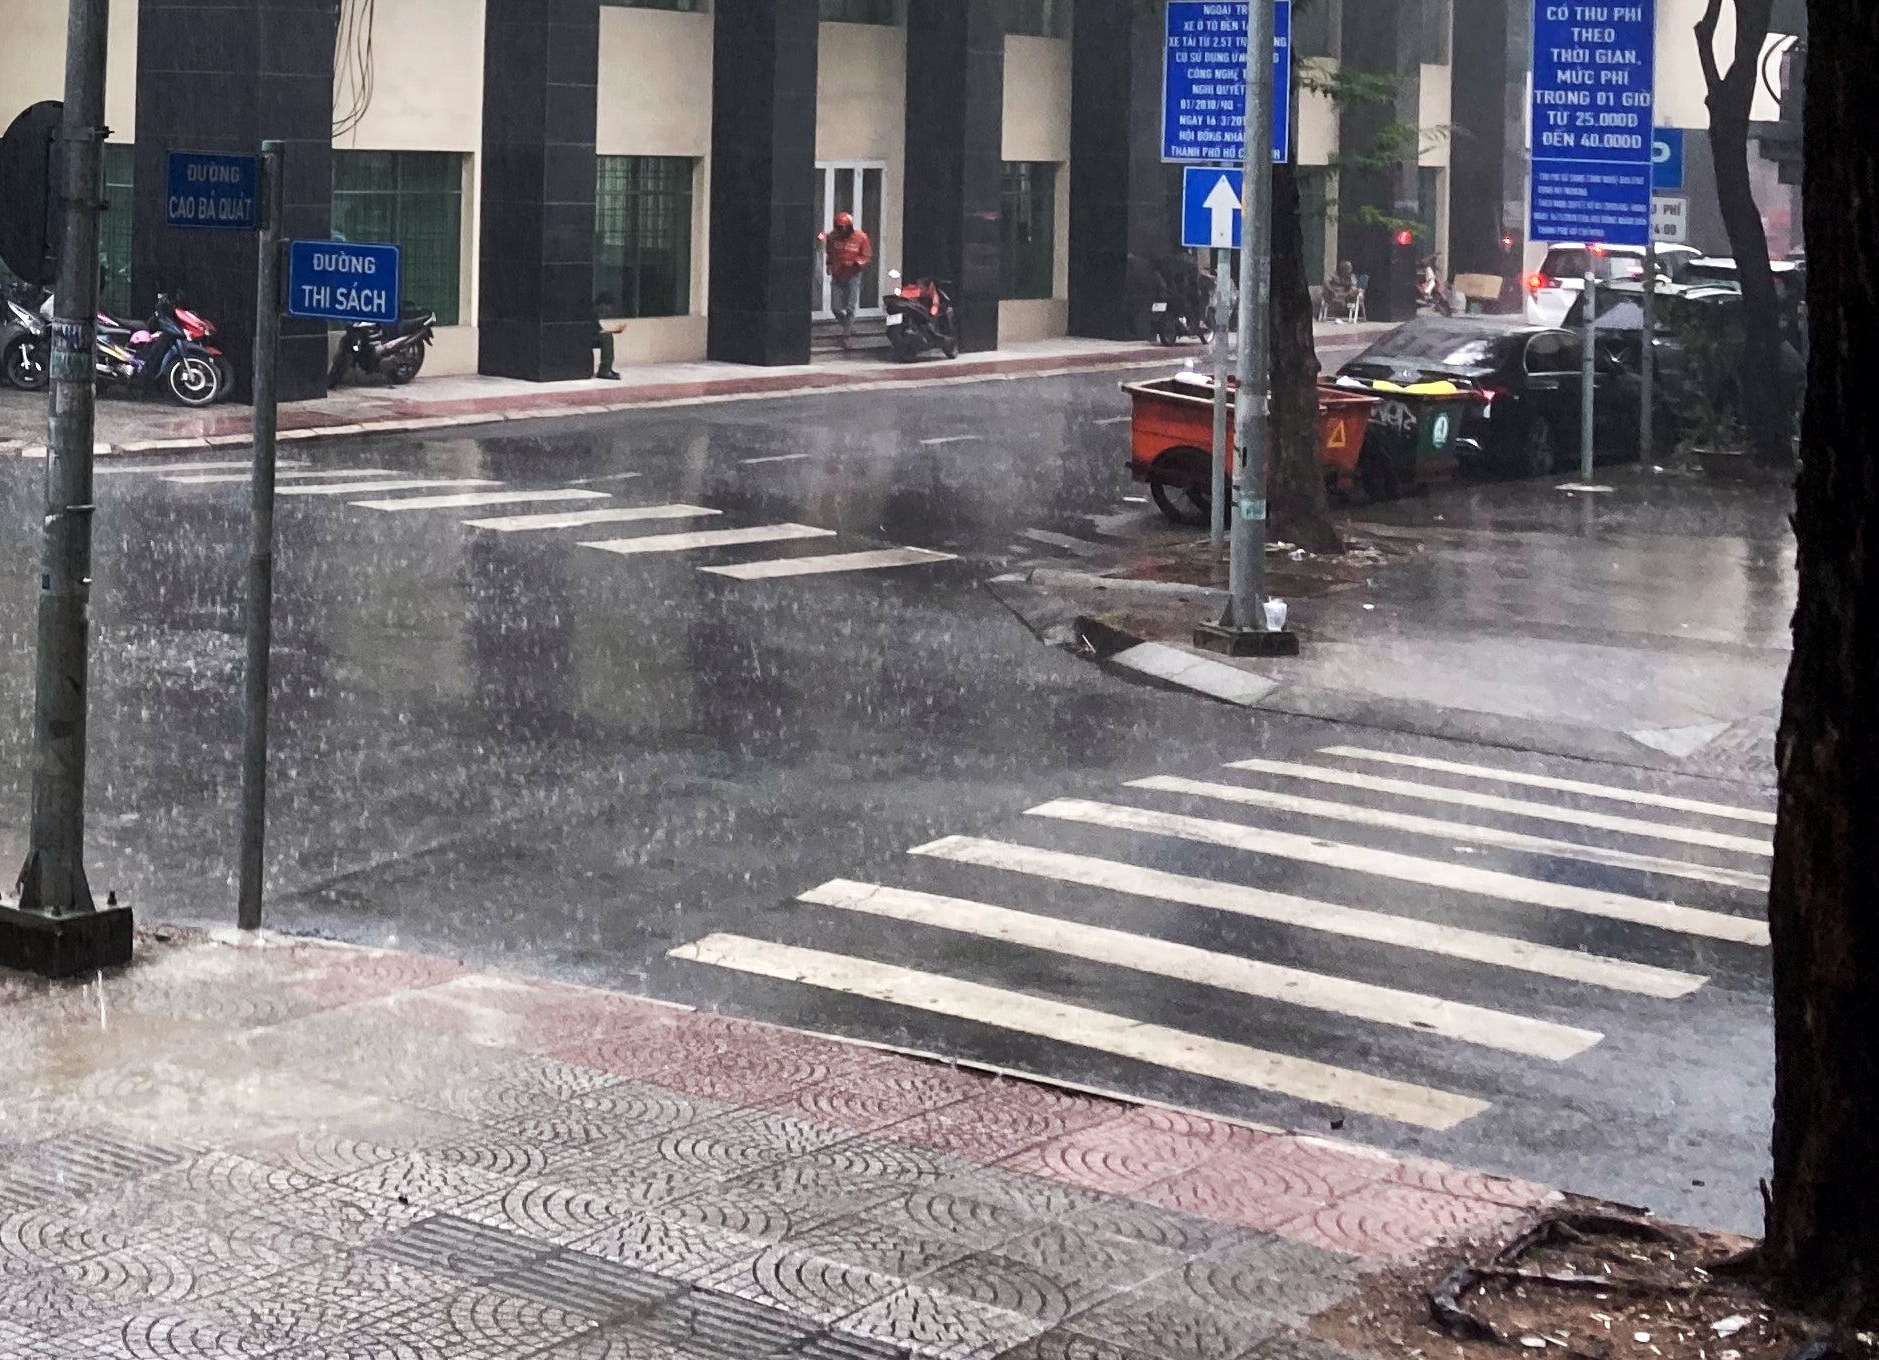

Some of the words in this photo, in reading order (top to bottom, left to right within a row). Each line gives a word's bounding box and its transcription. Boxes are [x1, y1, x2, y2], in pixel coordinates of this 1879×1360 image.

[1236, 4, 1249, 15] TR
[1546, 3, 1569, 21] CÓ
[1574, 7, 1607, 21] THU
[1613, 4, 1642, 22] PHÍ
[1571, 27, 1615, 43] THEO
[1550, 45, 1589, 63] THỜI
[1601, 68, 1629, 85] PHÍ
[1535, 90, 1590, 105] TRONG
[1597, 91, 1614, 106] 01
[1622, 89, 1651, 107] GIỜ
[1547, 107, 1570, 126] TỪ
[1542, 127, 1575, 146] ĐẾN
[187, 161, 239, 182] ĐƯỜNG
[169, 196, 195, 218] CAO
[198, 189, 216, 219] BÁ
[219, 193, 252, 220] QUÁT
[313, 251, 376, 274] ĐƯỜNG
[302, 285, 330, 308] THI
[335, 282, 386, 313] SÁCH
